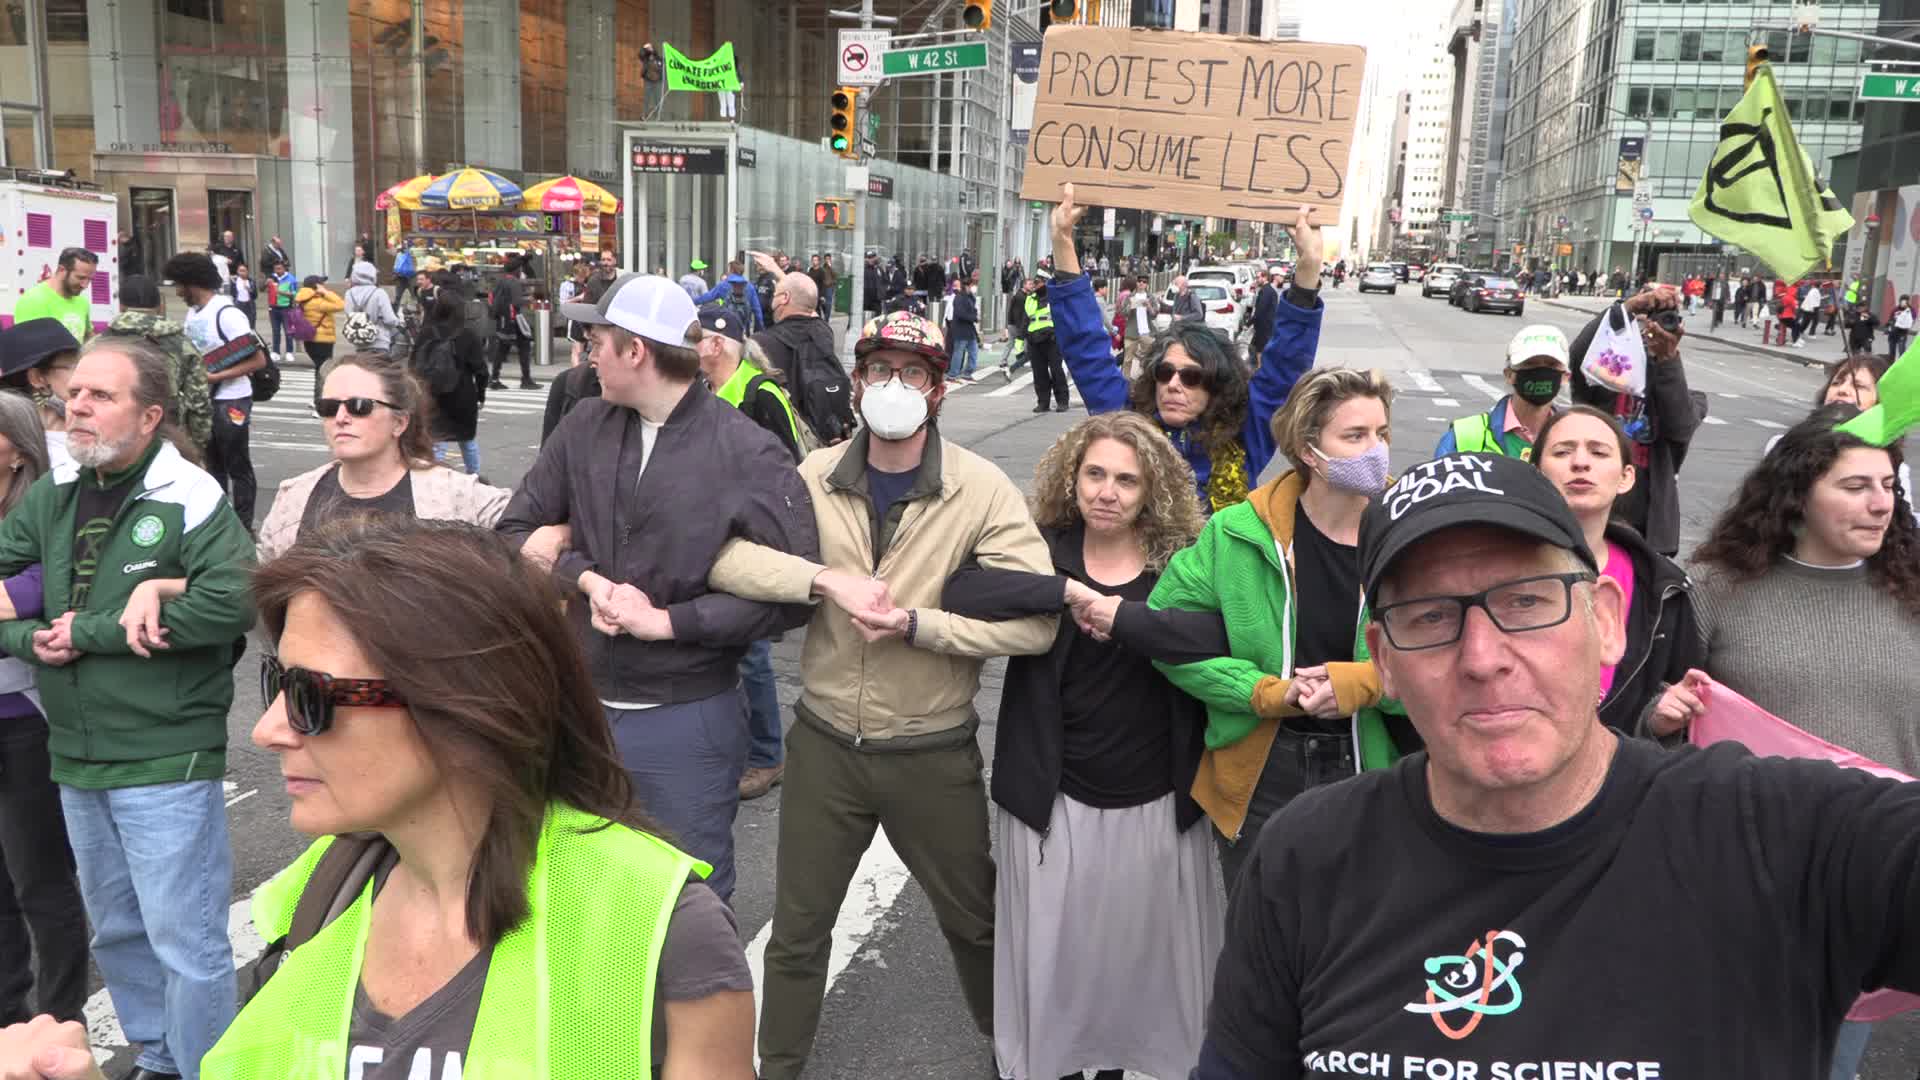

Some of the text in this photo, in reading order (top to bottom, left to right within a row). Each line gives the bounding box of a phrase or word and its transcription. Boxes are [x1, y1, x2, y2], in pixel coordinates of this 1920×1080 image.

[907, 50, 958, 69] W 42 St
[1049, 51, 1353, 121] PROTEST MORE
[1895, 79, 1908, 95] W
[1033, 120, 1343, 200] CONSUME LESS
[1636, 193, 1650, 202] 25
[1390, 471, 1504, 520] COAL
[1404, 1056, 1478, 1080] FOR
[1491, 1061, 1660, 1080] SCIENCE
